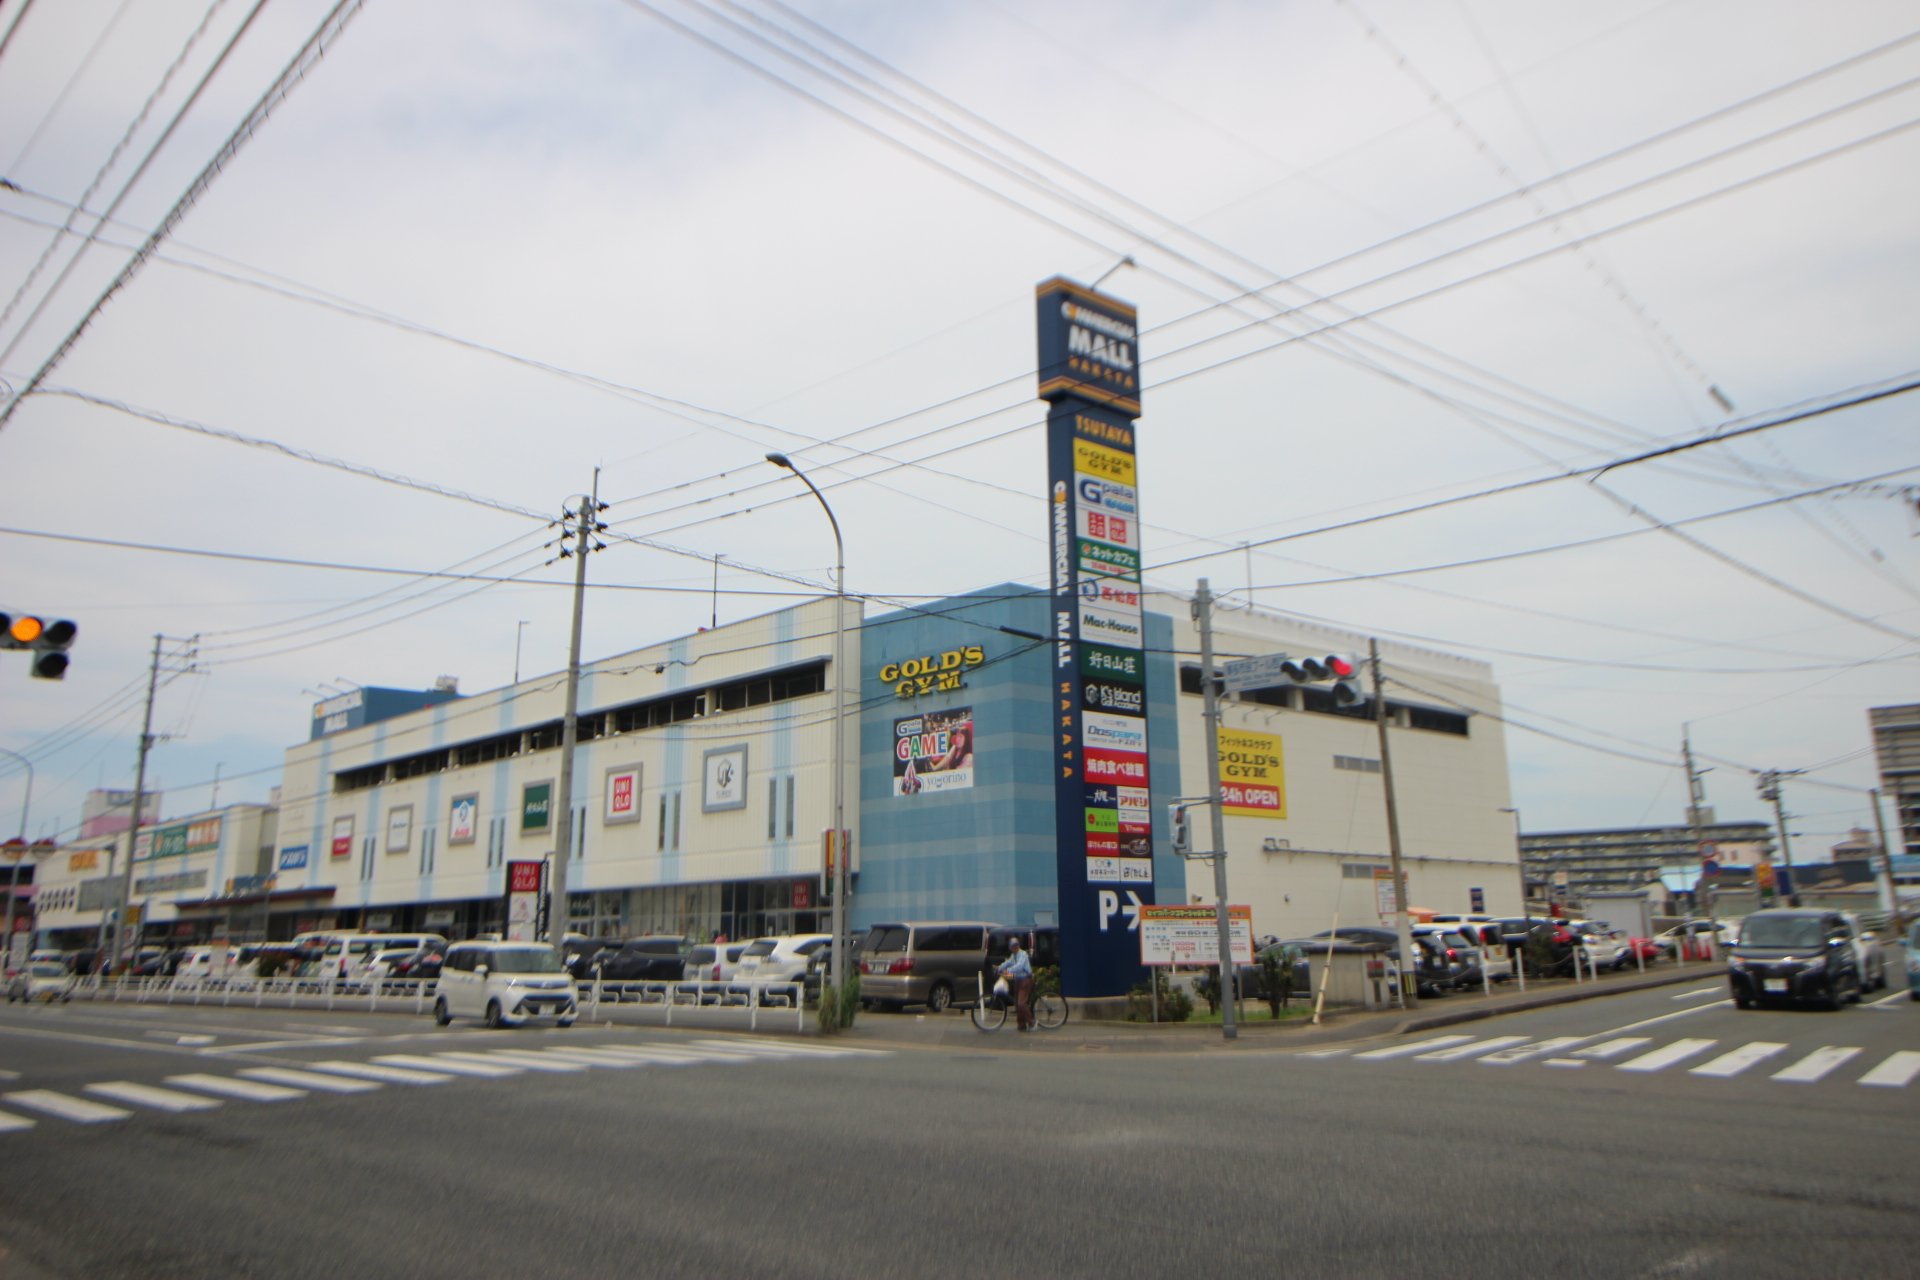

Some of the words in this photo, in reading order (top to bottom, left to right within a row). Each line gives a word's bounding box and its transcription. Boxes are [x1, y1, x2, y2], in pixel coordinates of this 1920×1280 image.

[1068, 324, 1134, 370] MALL
[1069, 355, 1134, 388] HAKATA
[1075, 414, 1132, 446] TSUTAYA
[1078, 446, 1132, 470] GOLD'S
[1088, 458, 1122, 475] GYM
[1053, 480, 1069, 596] COMMERCIAL
[1083, 614, 1138, 635] Mac-House
[1057, 611, 1072, 668] MALL
[880, 645, 985, 682] GOLD'S
[1088, 650, 1136, 673] 好日山荘
[895, 670, 962, 699] GYM
[1061, 682, 1073, 779] HAKATA
[1088, 725, 1142, 740] Dospara
[897, 733, 948, 761] GAME
[1219, 735, 1273, 751] フィットネスクラブ
[1087, 758, 1145, 777] 焼肉食べ放題
[1217, 750, 1280, 769] GOLD'S
[1226, 765, 1268, 778] GYM
[615, 780, 630, 793] UNI
[1220, 786, 1243, 804] 24h
[1245, 788, 1279, 806] OPEN
[614, 794, 630, 809] QLO
[514, 864, 536, 876] UNI
[514, 877, 537, 888] QLO
[1098, 889, 1119, 931] P
